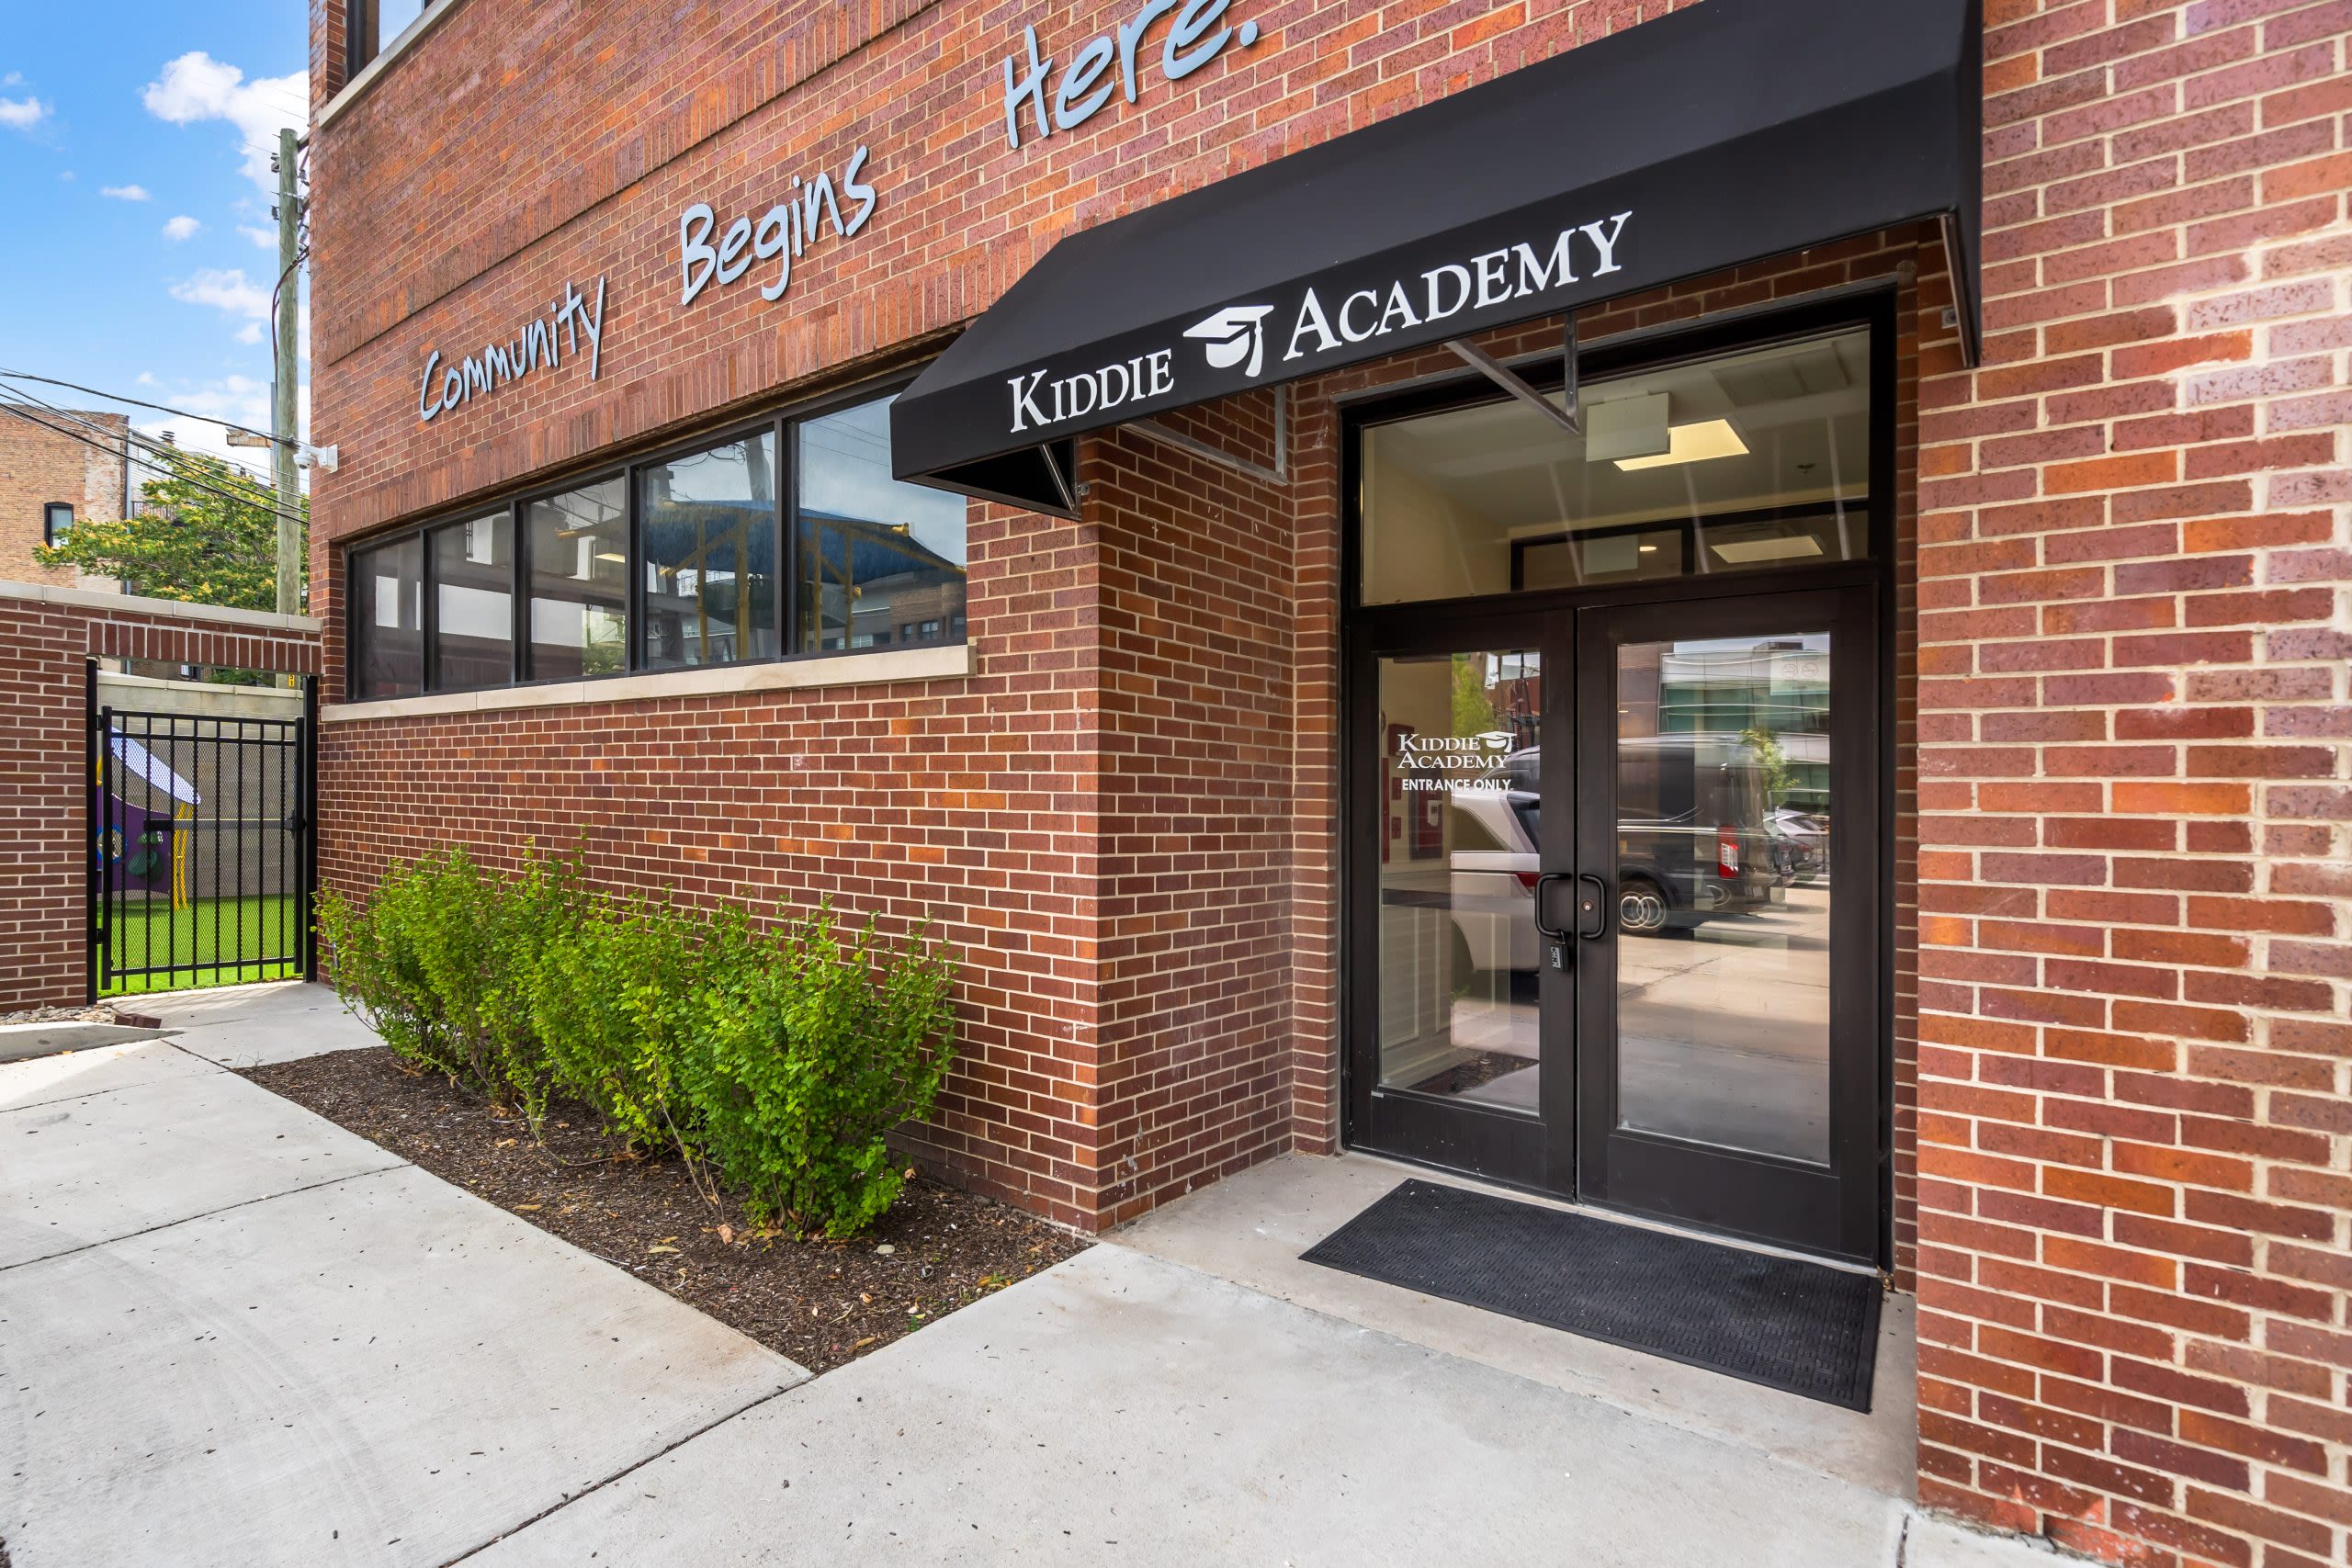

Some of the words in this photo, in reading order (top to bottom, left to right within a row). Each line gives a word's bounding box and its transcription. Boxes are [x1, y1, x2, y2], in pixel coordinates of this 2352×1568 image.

[420, 276, 605, 422] Community
[681, 145, 877, 303] Begins
[1004, 0, 1259, 149] Here.
[1007, 348, 1174, 434] KIDDIE
[1282, 210, 1634, 362] ACADEMY
[1397, 733, 1481, 751] KIDDIE
[1397, 750, 1510, 769] ACADEMY
[1402, 778, 1470, 791] ENTRANCE
[1474, 778, 1511, 791] ONLY
